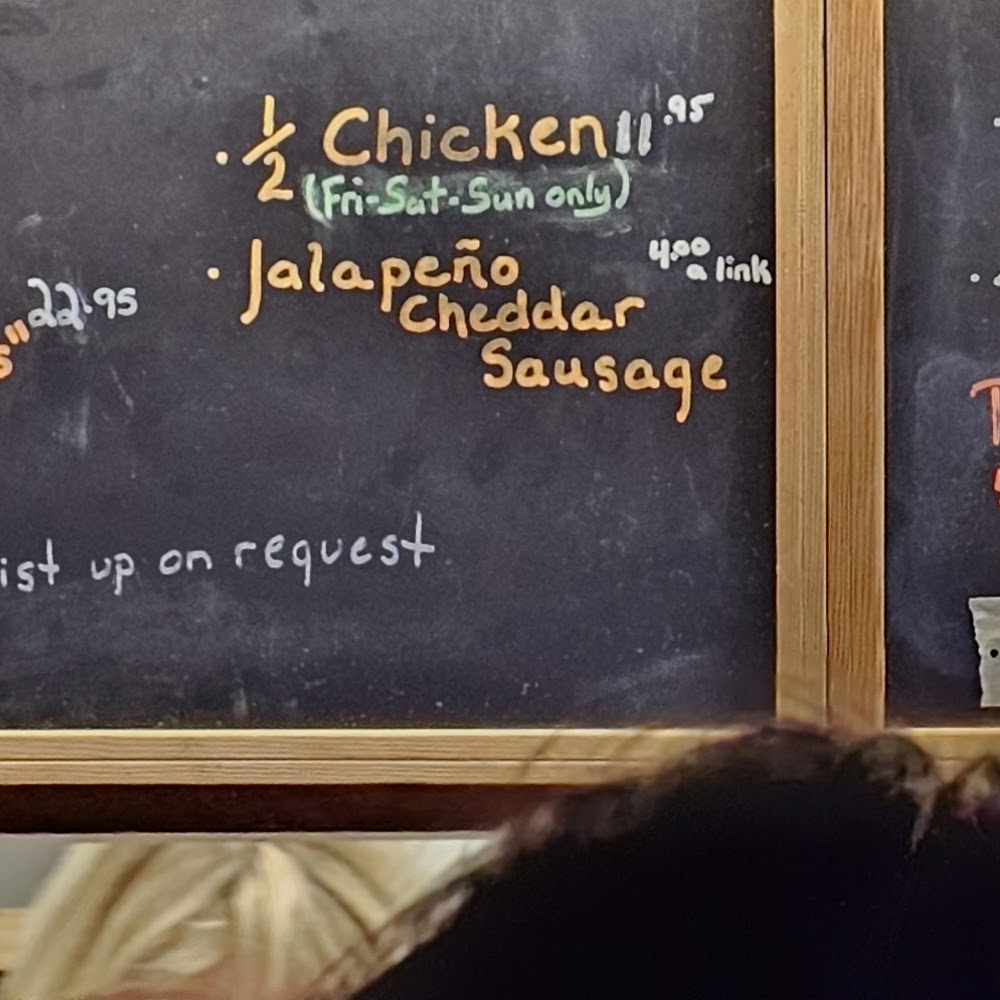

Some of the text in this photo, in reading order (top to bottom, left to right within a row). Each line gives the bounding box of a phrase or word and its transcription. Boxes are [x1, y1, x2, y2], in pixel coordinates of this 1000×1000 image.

[322, 104, 607, 166] Chicken
[302, 158, 631, 227] (Fri-Sat-Sun only)
[686, 262, 708, 282] a
[715, 254, 773, 285] link
[27, 277, 138, 330] 22.95
[480, 338, 728, 424] Sausage
[91, 553, 135, 596] up
[159, 550, 213, 577] on
[234, 510, 436, 588] request
